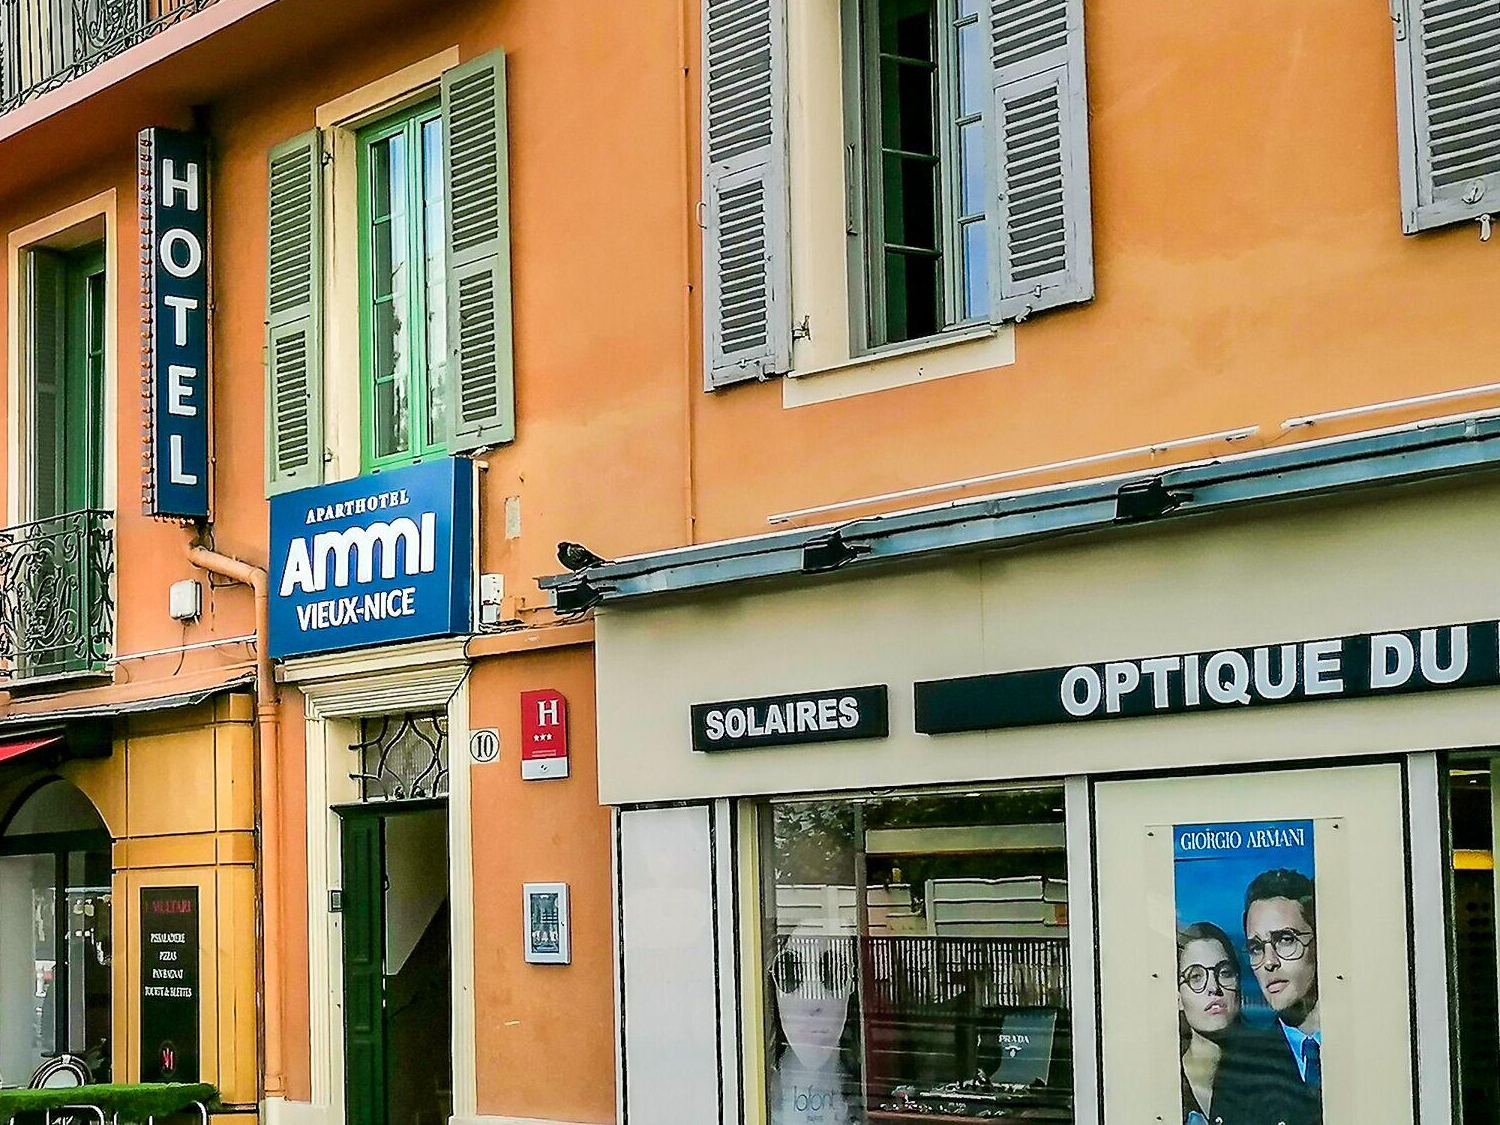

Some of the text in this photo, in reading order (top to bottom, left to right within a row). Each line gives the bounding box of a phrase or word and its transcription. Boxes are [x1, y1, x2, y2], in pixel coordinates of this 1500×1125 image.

[159, 157, 202, 486] HOTEL
[305, 489, 410, 525] APARTHOTEL
[296, 586, 417, 632] VIEUX-NICE
[1060, 639, 1345, 717] OPTIQUE
[1370, 625, 1469, 690] DU
[537, 699, 560, 727] H
[705, 696, 860, 741] SOLAIRES
[476, 734, 494, 758] 10
[1180, 828, 1305, 850] GIORGIO ARMANI
[999, 1035, 1030, 1044] PRADA
